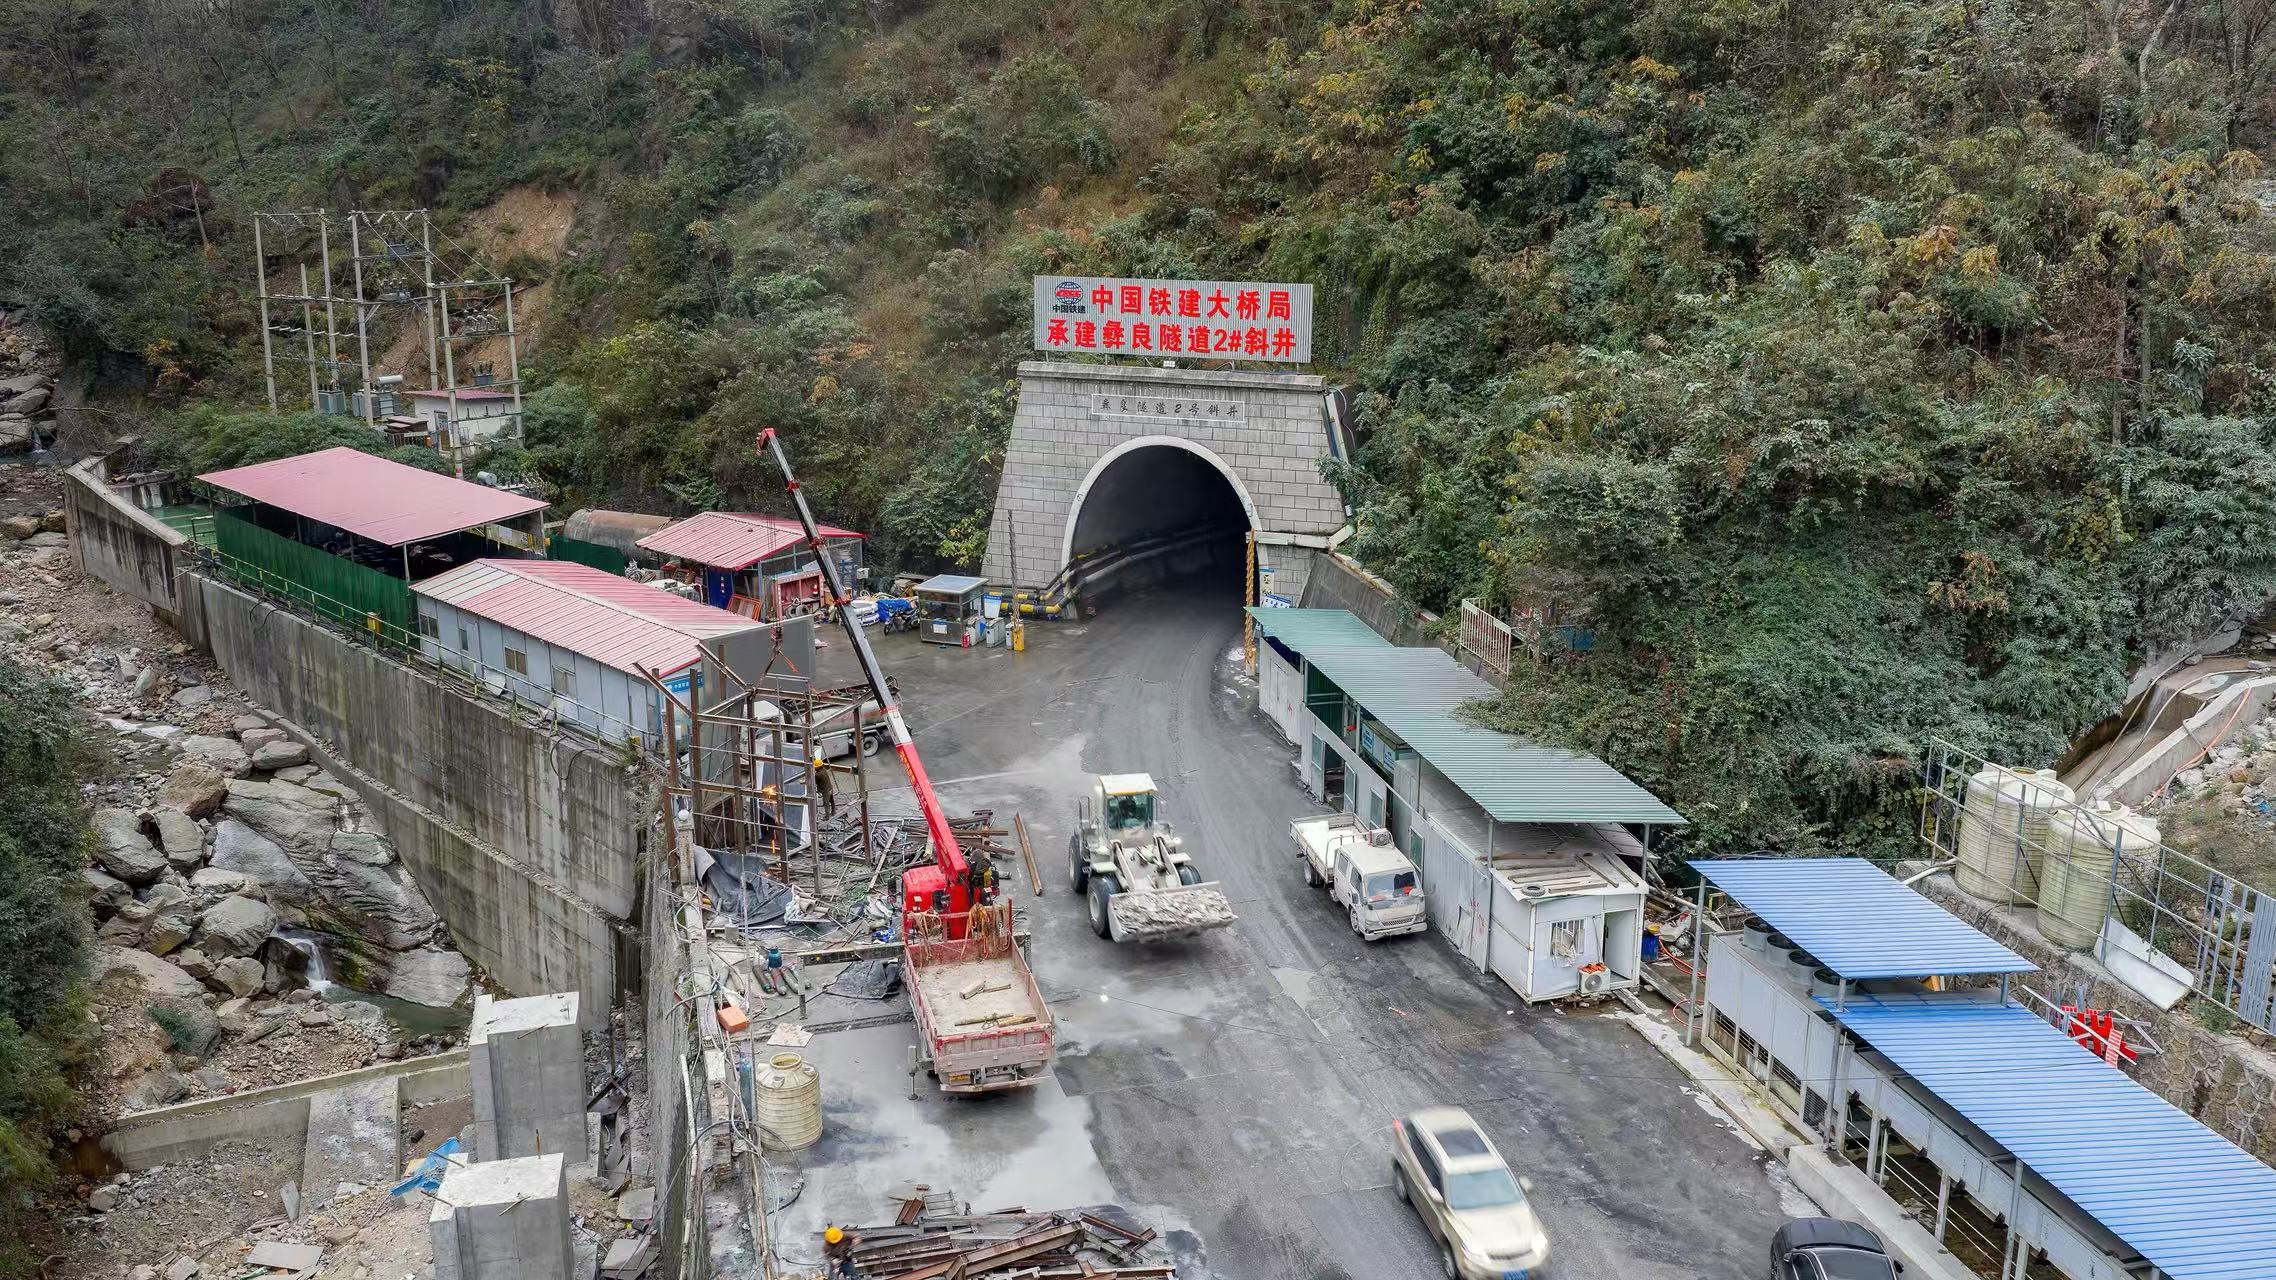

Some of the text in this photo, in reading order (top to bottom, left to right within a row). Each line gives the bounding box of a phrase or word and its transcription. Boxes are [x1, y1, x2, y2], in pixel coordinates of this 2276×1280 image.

[1053, 304, 1086, 313] 中国铁建
[1092, 284, 1291, 320] 中国铁建大桥局
[1047, 319, 1296, 357] 承建彝良隧道2#斜井
